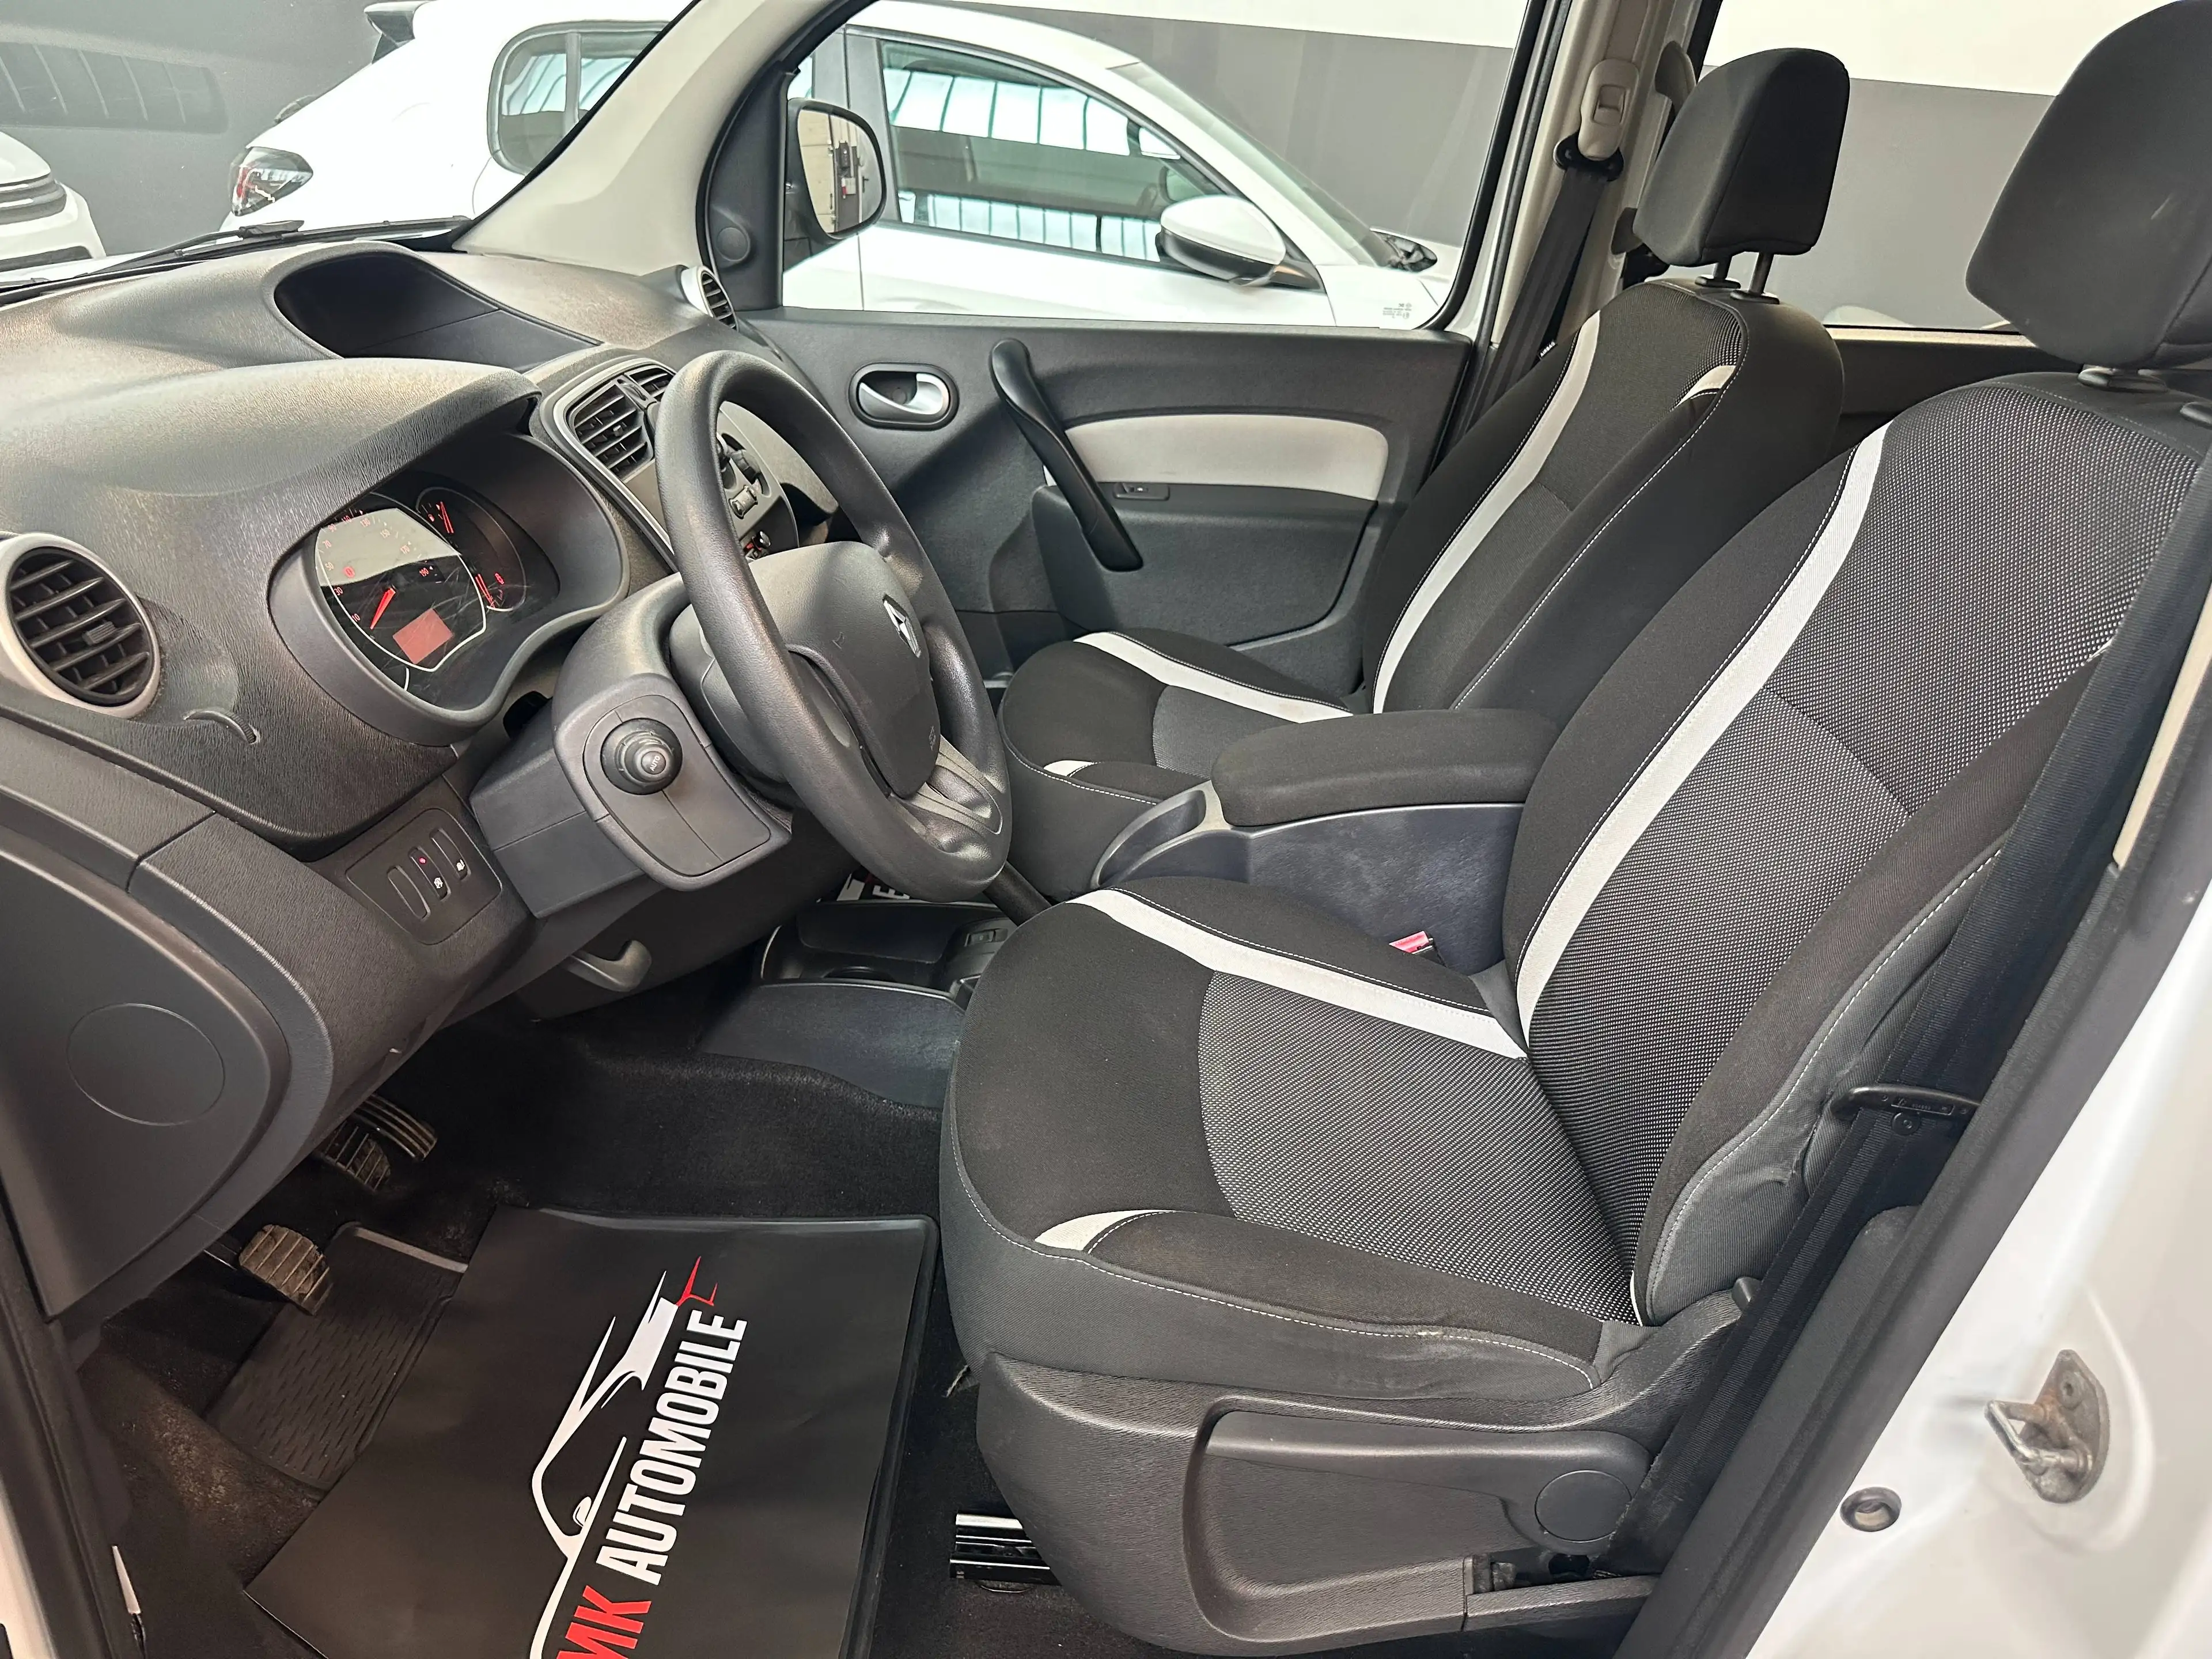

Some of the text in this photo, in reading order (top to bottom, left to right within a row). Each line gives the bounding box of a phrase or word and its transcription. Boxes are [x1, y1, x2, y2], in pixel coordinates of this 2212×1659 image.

[360, 517, 370, 528] 130
[328, 524, 337, 532] 90
[380, 529, 390, 539] 150
[322, 540, 332, 548] 70
[400, 545, 410, 554] 170
[325, 562, 334, 571] 50
[419, 567, 429, 577] 190
[334, 586, 343, 596] 30
[352, 613, 361, 622] 10
[650, 755, 661, 772] AUTO
[556, 1309, 748, 1659] MK AUTOMOBILE
